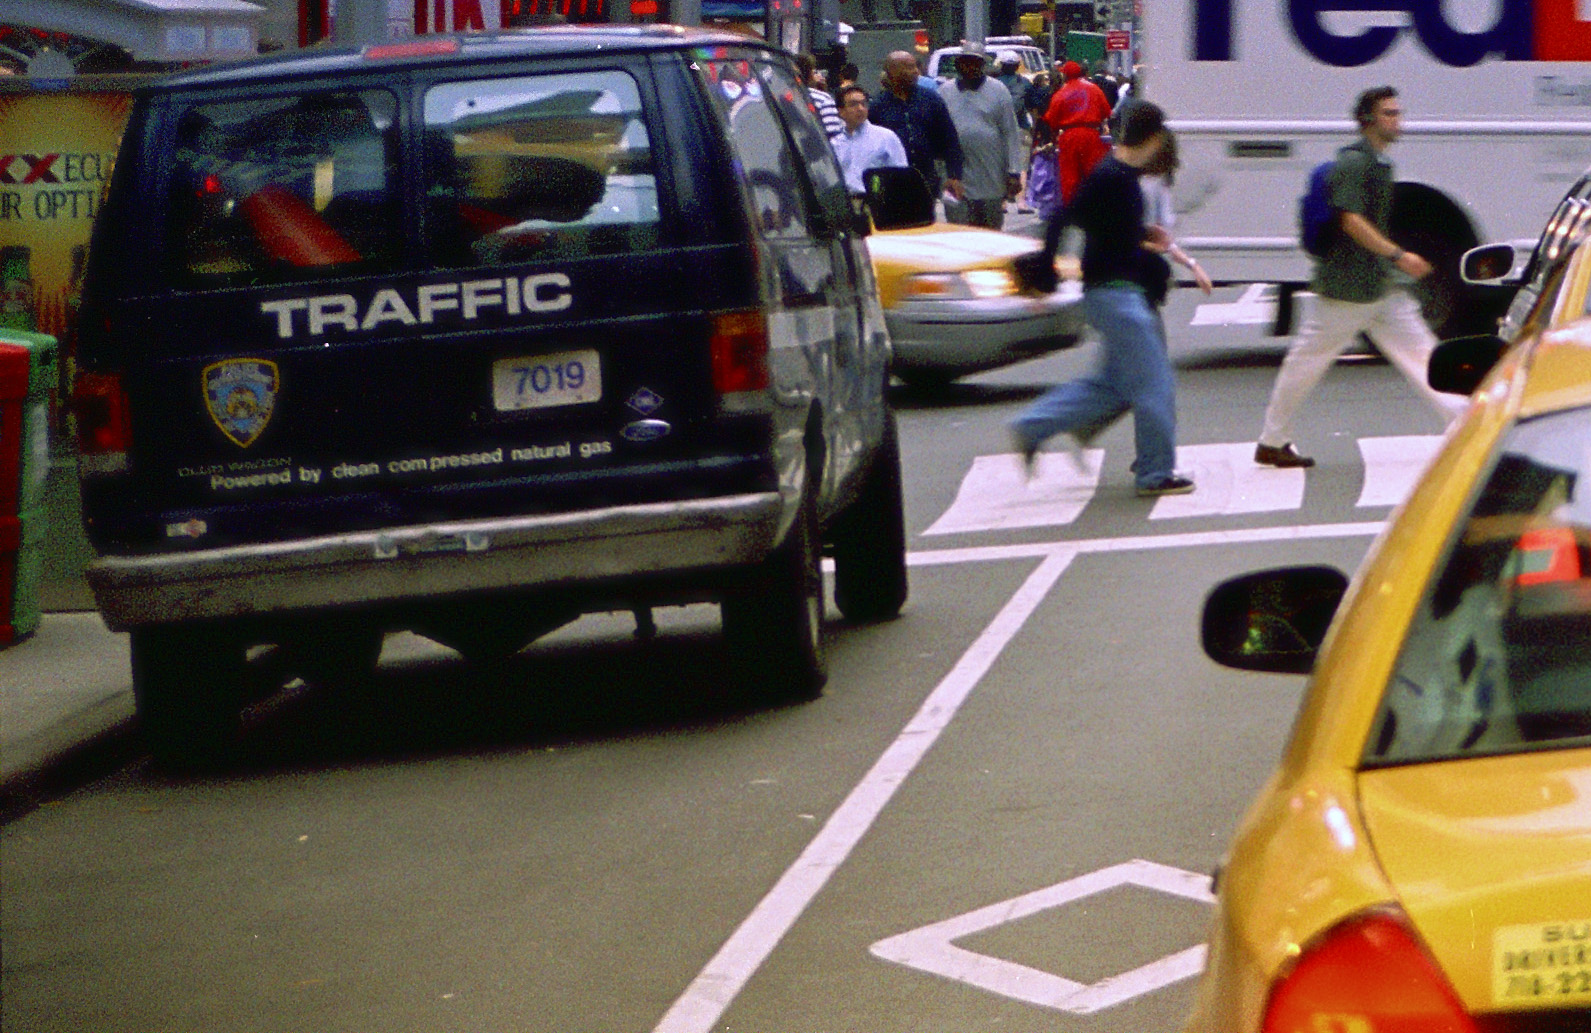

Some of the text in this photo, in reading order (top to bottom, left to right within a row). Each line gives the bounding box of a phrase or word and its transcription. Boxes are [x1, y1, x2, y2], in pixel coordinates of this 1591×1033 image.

[260, 272, 573, 338] TRAFFIC
[511, 360, 586, 396] 7019
[210, 469, 292, 491] Powered
[299, 466, 322, 484] by
[332, 462, 380, 479] clean
[511, 441, 572, 461] natural
[579, 440, 613, 458] gas
